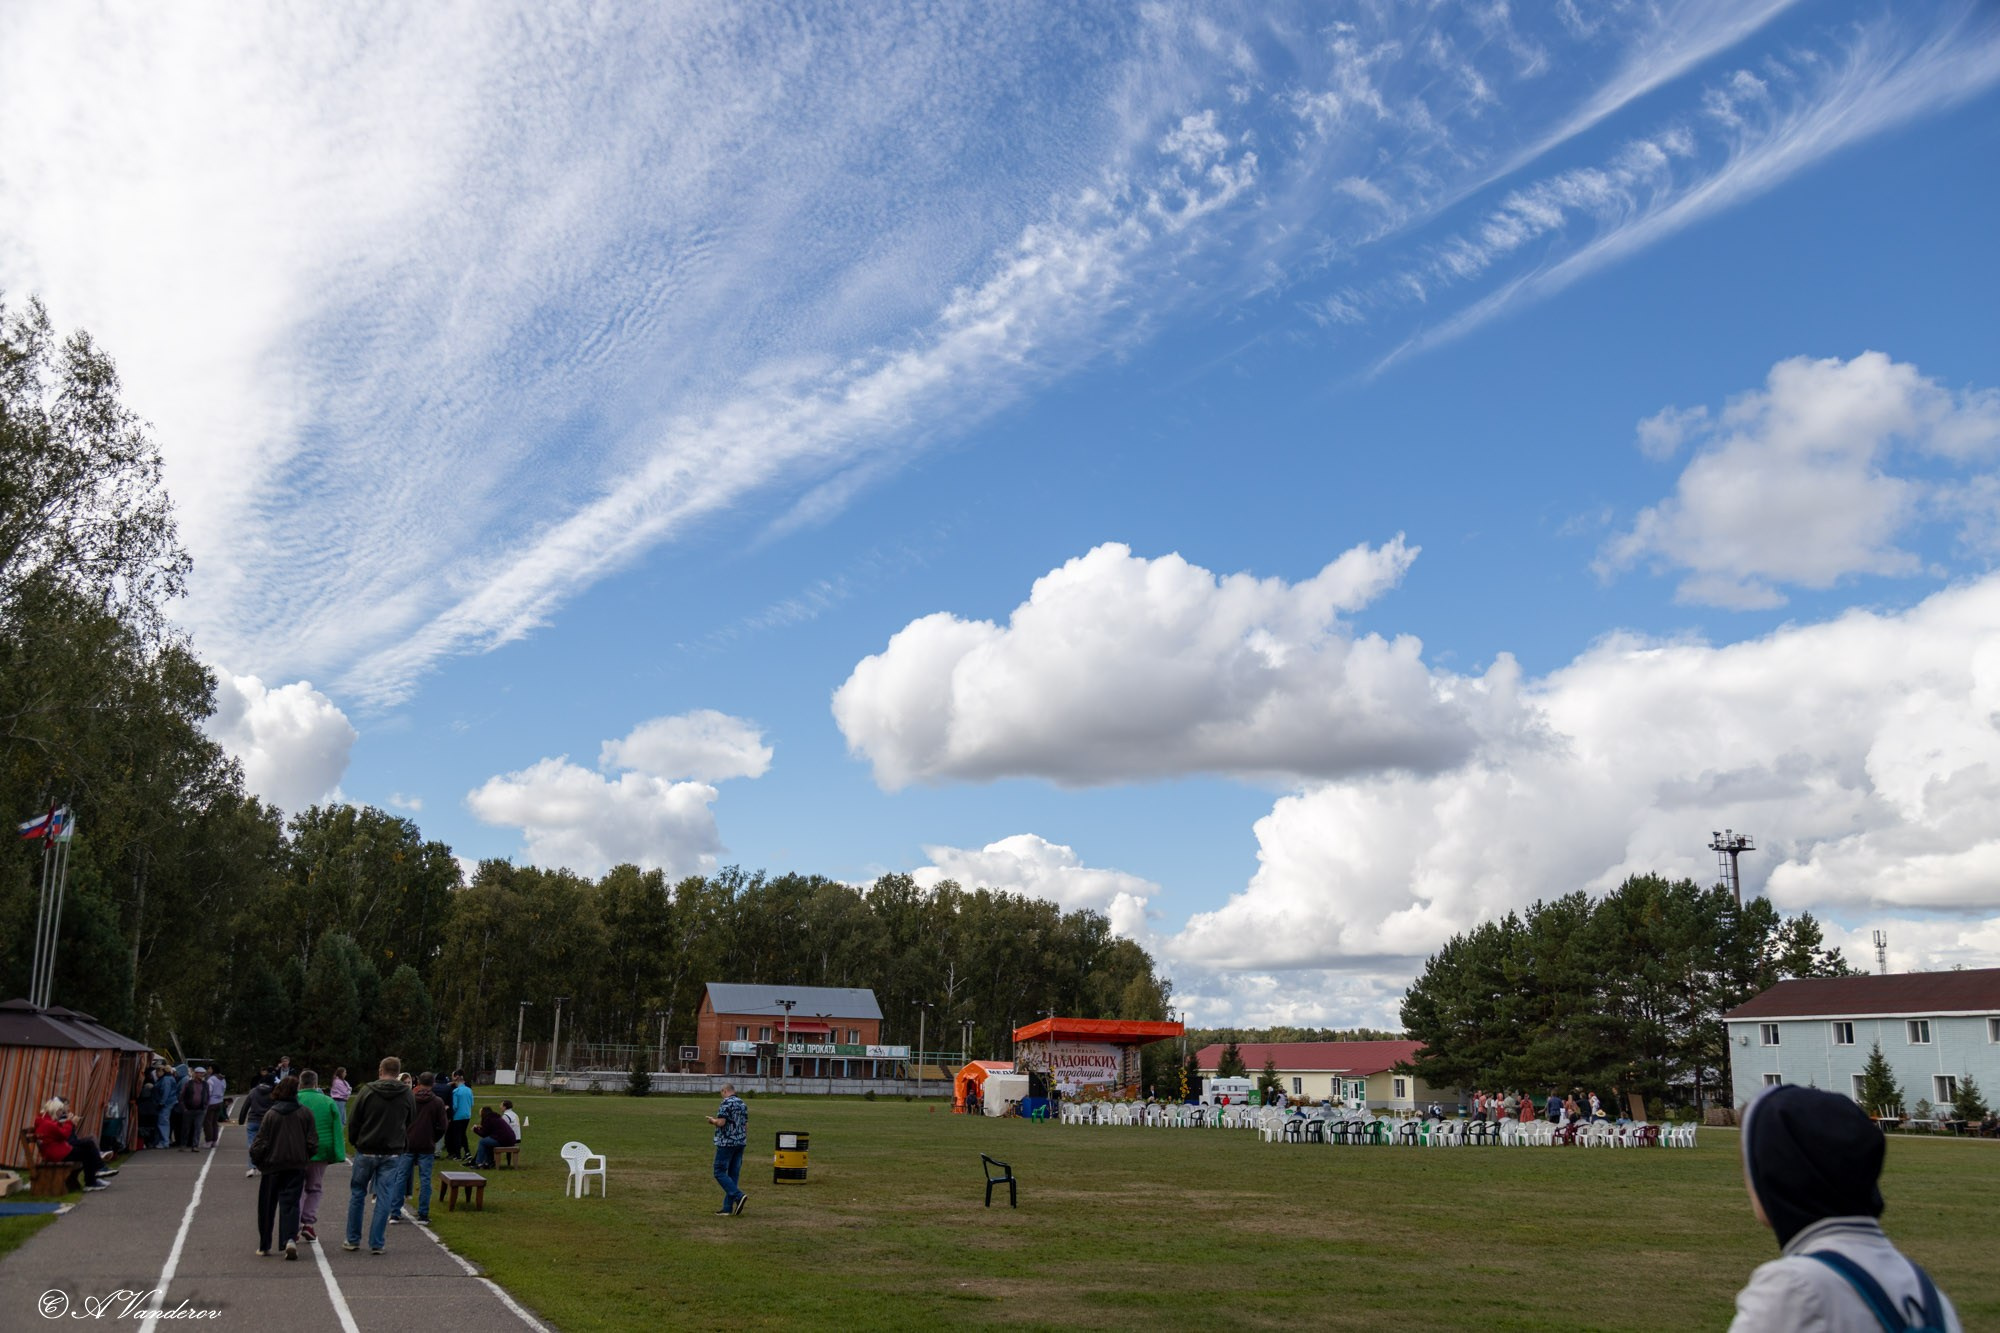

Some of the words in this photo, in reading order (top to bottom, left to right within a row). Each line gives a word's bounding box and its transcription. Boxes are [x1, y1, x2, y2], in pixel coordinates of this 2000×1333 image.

[787, 1043, 805, 1054] БАЗА
[807, 1043, 836, 1054] ПРОКАТА
[1057, 1067, 1105, 1080] традиций
